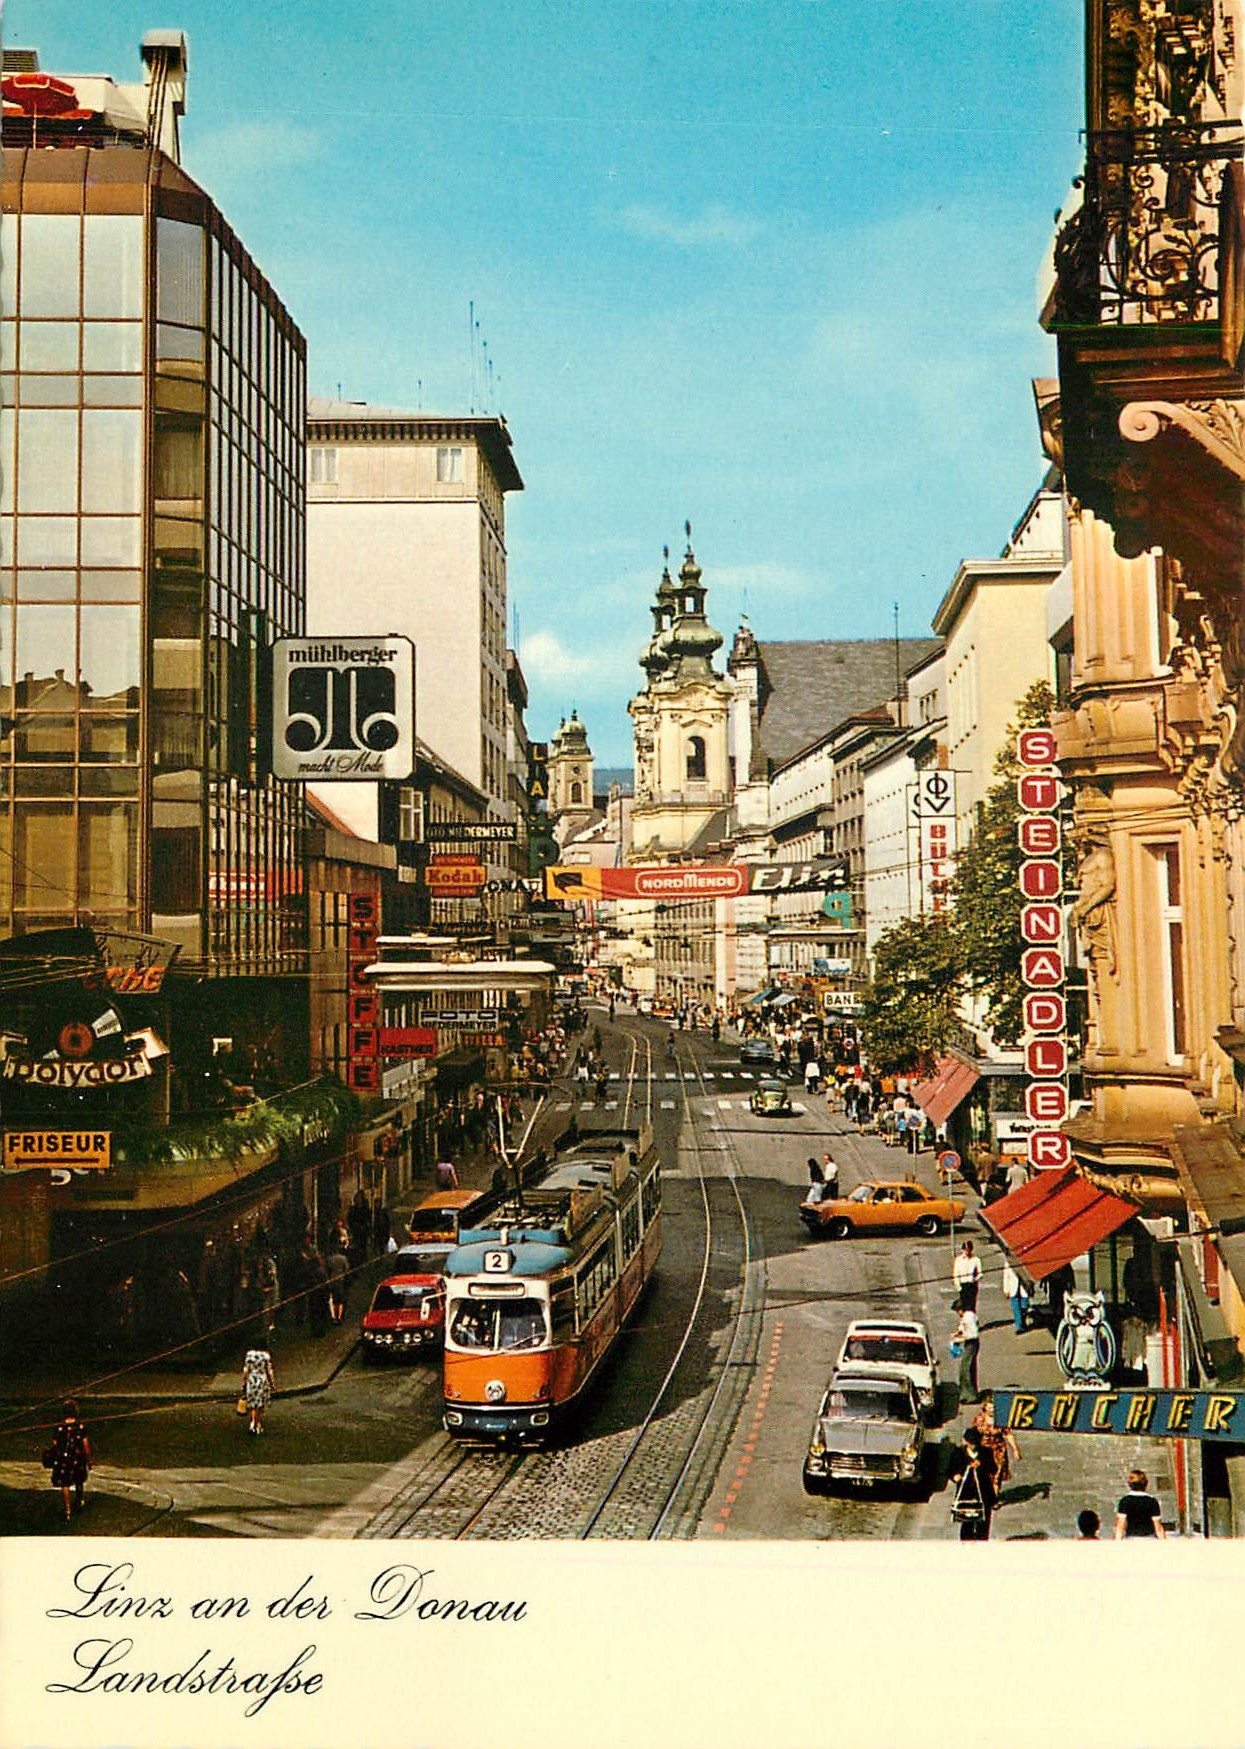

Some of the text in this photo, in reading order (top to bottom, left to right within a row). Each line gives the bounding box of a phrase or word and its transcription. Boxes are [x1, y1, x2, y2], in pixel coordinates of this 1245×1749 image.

[289, 645, 398, 665] mühlberger
[298, 751, 384, 773] macht Mode
[428, 869, 483, 883] Kodak
[642, 873, 737, 889] NORDMENDE
[1025, 737, 1063, 1162] STEINADLER
[352, 896, 374, 1087] STOFFE
[421, 1010, 497, 1020] FOTO
[9, 1135, 106, 1153] FRISEUR
[492, 1254, 502, 1268] 2
[1007, 1393, 1236, 1432] BÜCHER
